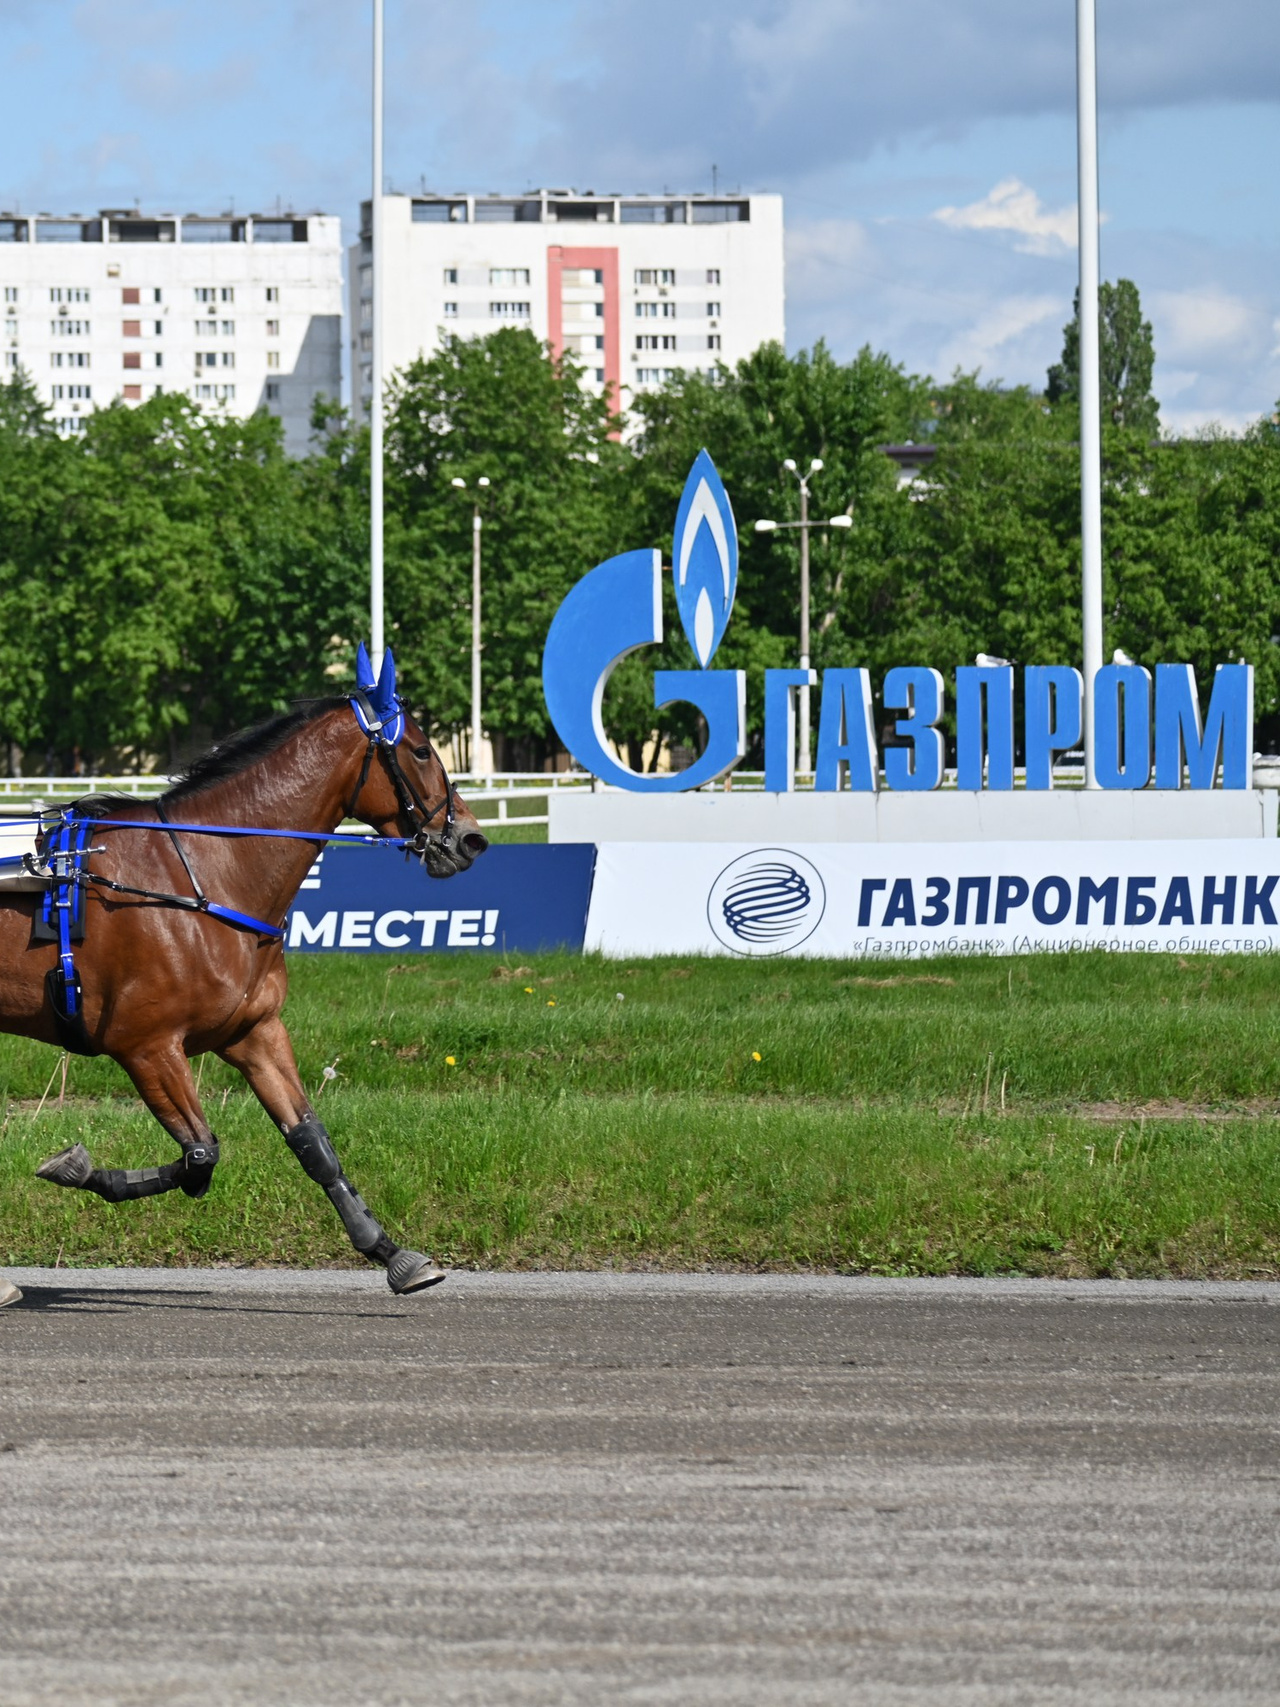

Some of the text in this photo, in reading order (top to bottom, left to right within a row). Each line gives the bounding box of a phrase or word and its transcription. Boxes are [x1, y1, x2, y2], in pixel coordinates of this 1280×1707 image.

[765, 664, 1254, 792] ГАЗПРОМ
[857, 875, 1280, 927] ГАЗПРОМБАНК
[284, 909, 499, 948] МЕСТЕ!
